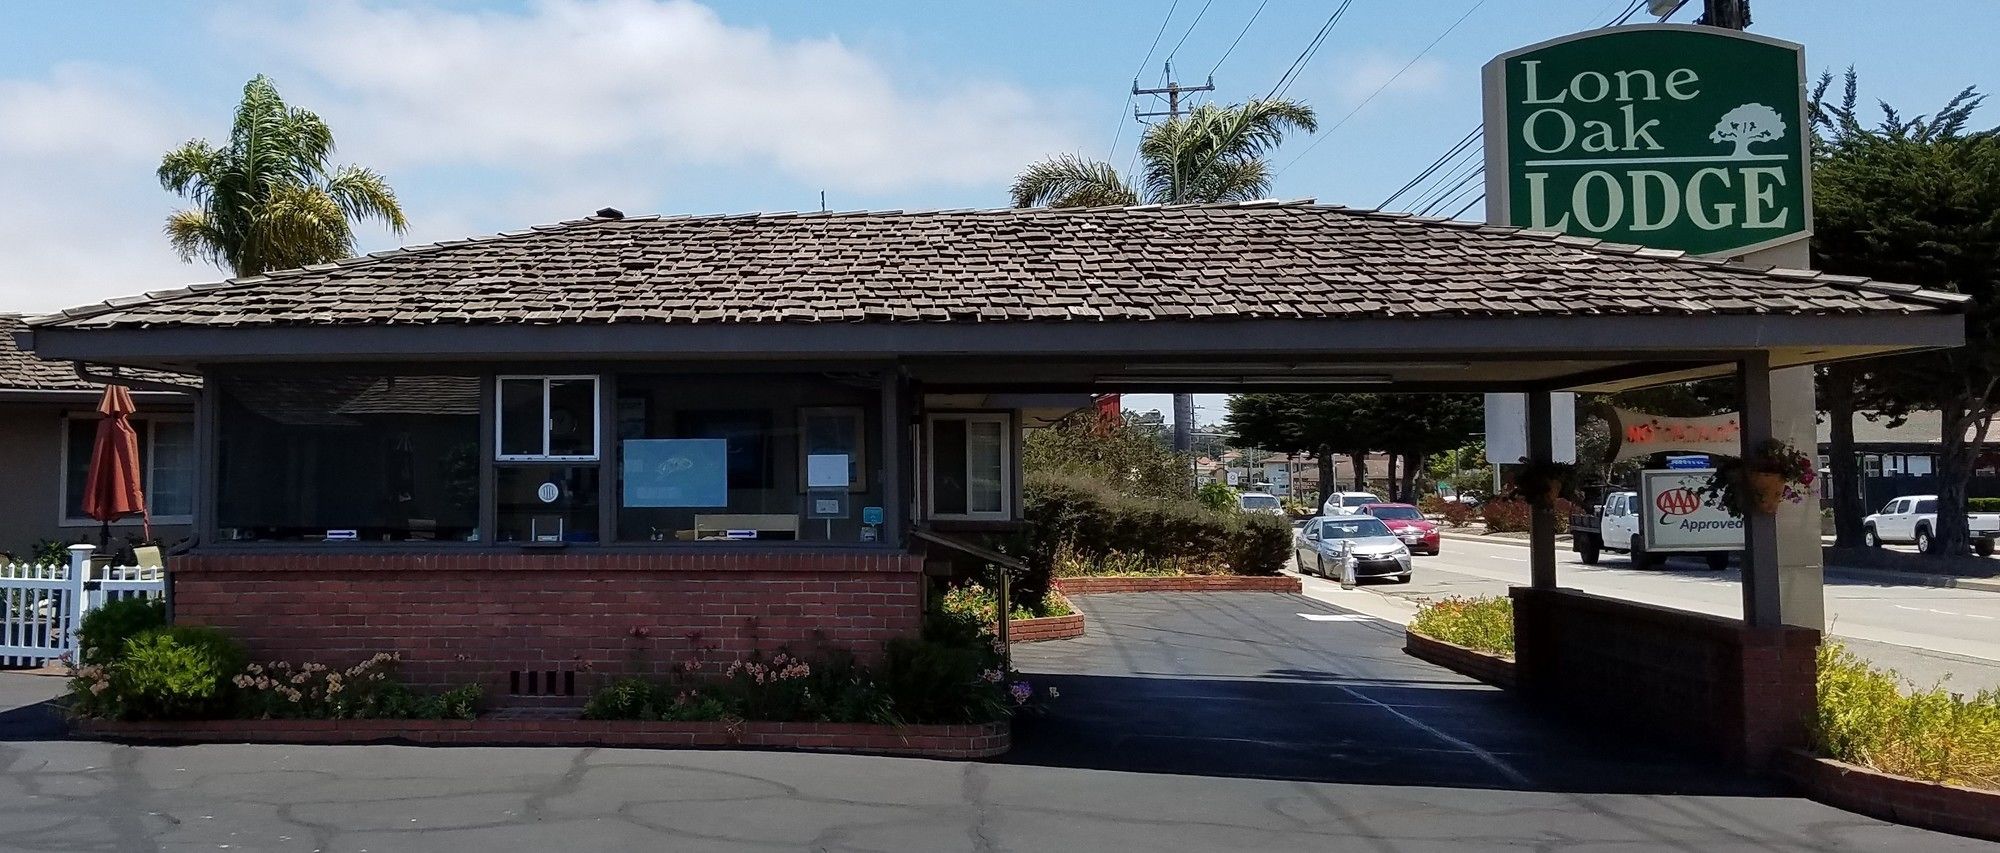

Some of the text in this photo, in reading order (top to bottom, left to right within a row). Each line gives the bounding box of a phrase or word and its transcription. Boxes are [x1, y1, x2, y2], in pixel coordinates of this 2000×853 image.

[1520, 60, 1700, 104] Lone
[1522, 104, 1665, 154] Oak
[1524, 166, 1789, 233] LODGE
[1660, 489, 1698, 514] AAA
[1680, 518, 1743, 532] Approved
